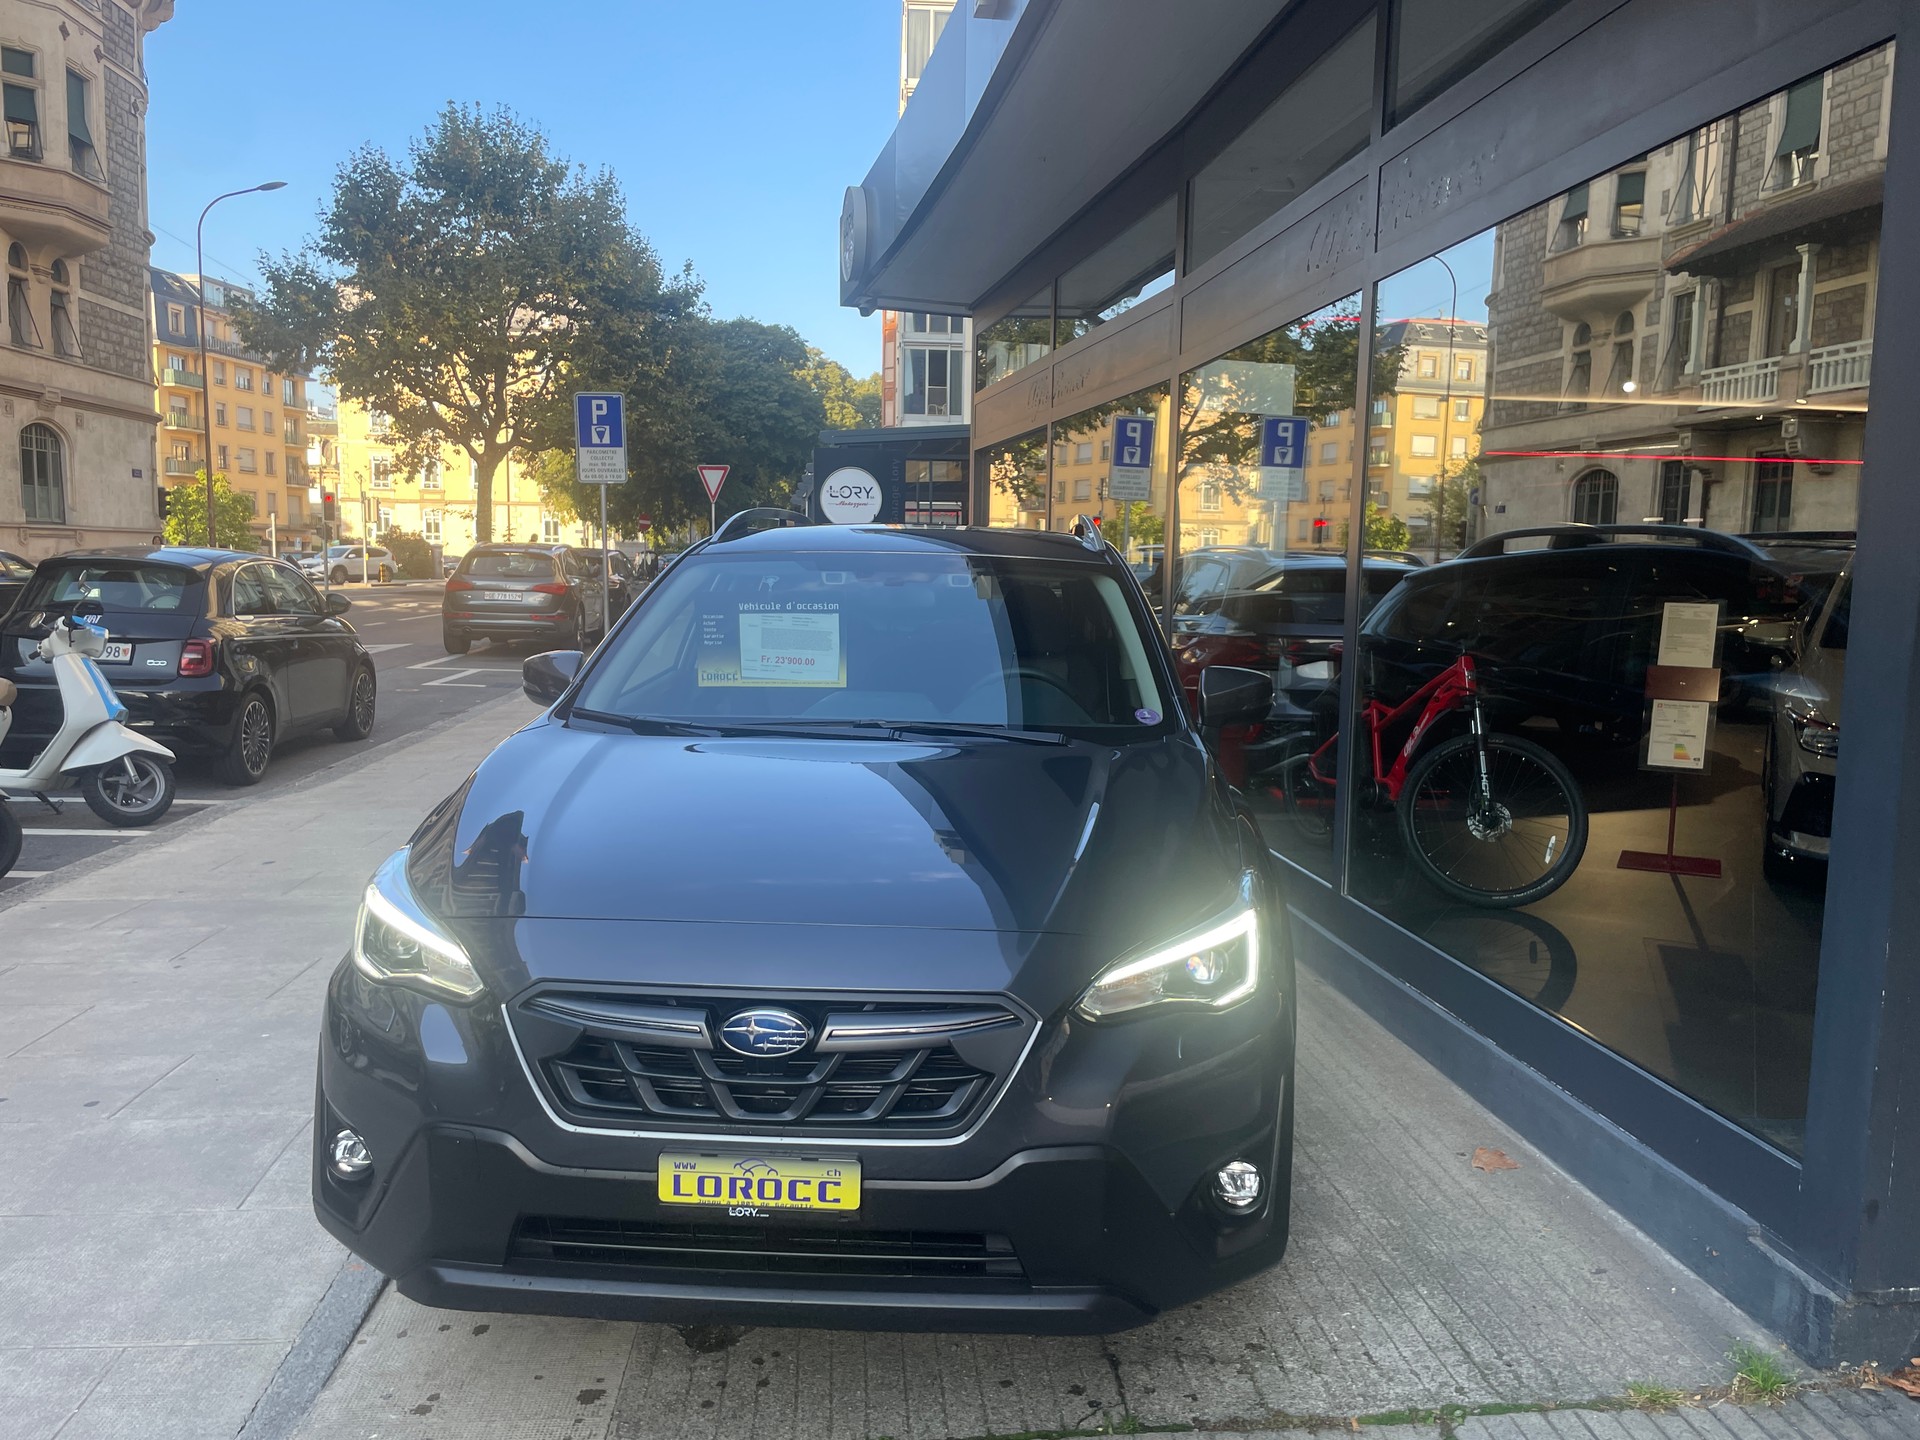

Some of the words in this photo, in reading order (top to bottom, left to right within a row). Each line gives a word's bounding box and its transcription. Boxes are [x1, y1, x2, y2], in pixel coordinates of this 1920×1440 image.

[592, 400, 607, 424] P
[830, 486, 873, 498] LORY
[738, 602, 781, 611] Véhicule
[786, 601, 839, 610] d'occasion
[84, 614, 102, 623] FIAT
[761, 655, 773, 664] Fr.
[775, 656, 815, 666] 23'900.00
[701, 672, 738, 681] LOROCC
[673, 1174, 842, 1203] LOROCC
